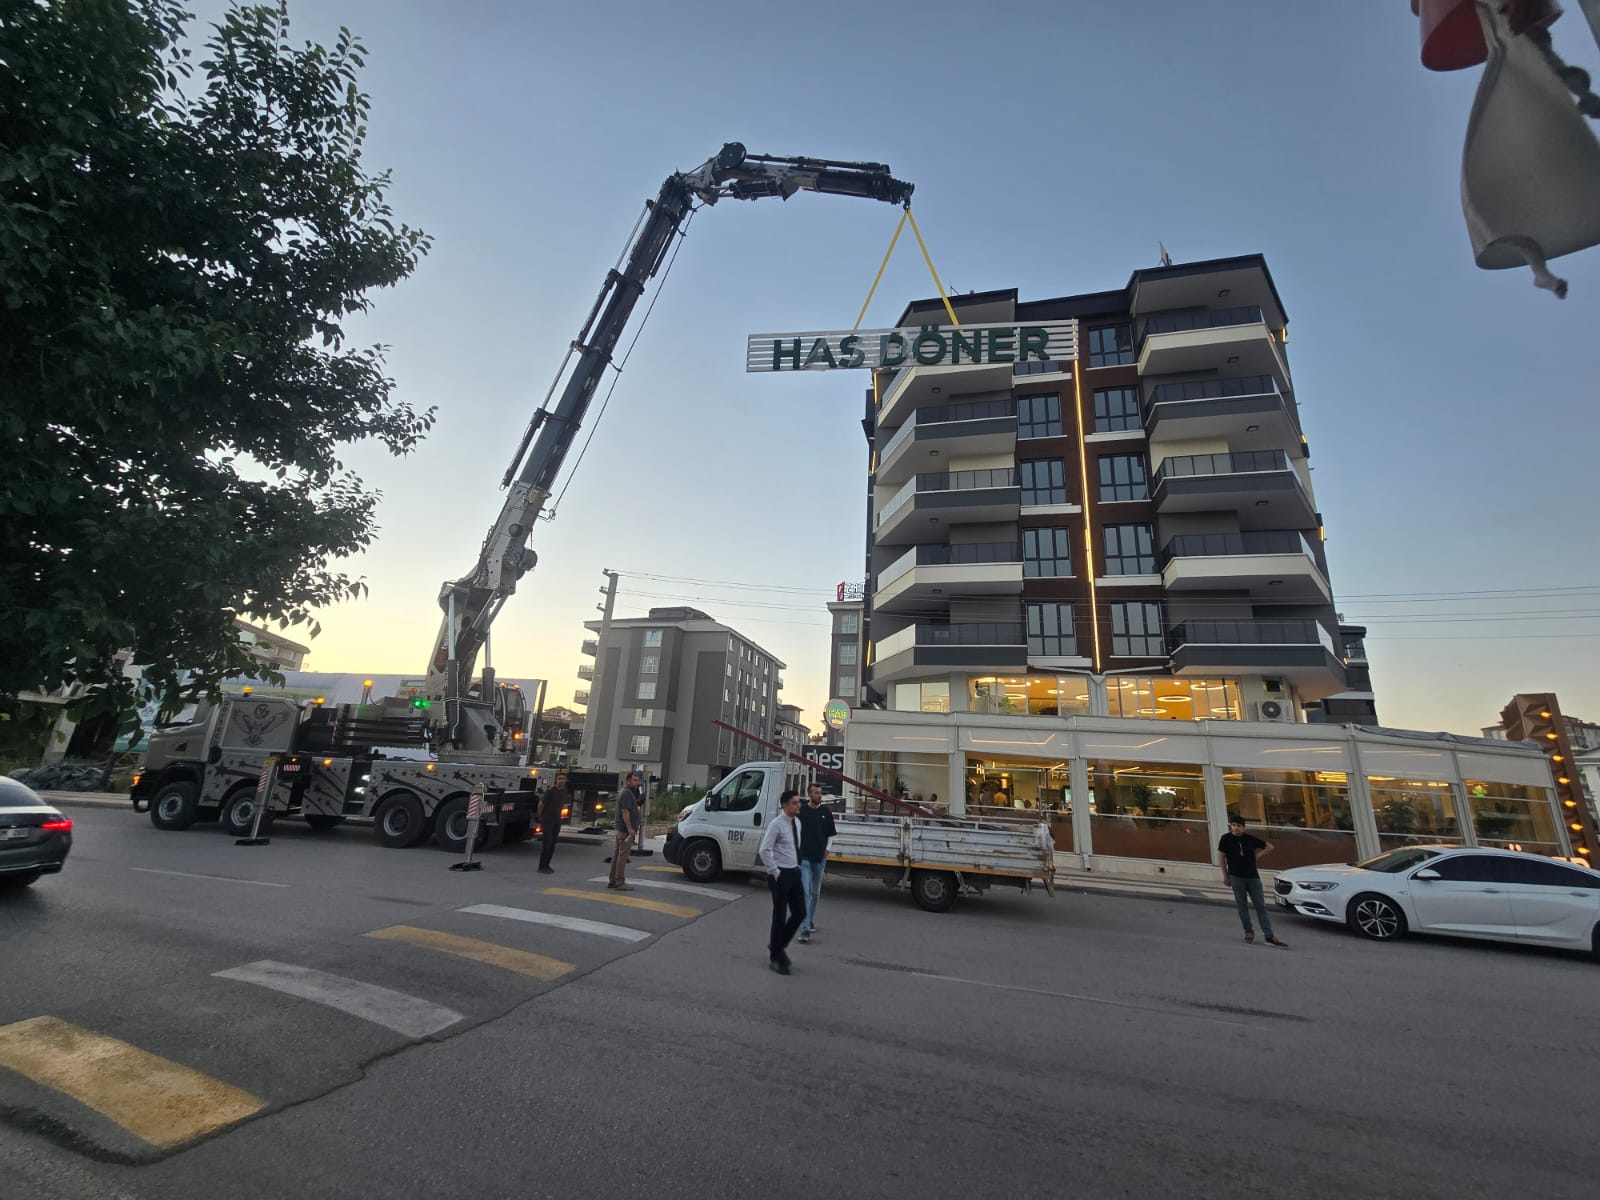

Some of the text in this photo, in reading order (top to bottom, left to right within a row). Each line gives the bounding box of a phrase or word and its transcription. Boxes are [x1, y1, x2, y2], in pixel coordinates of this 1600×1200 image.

[773, 324, 1050, 370] HAS DÖNER
[728, 830, 745, 841] nev
